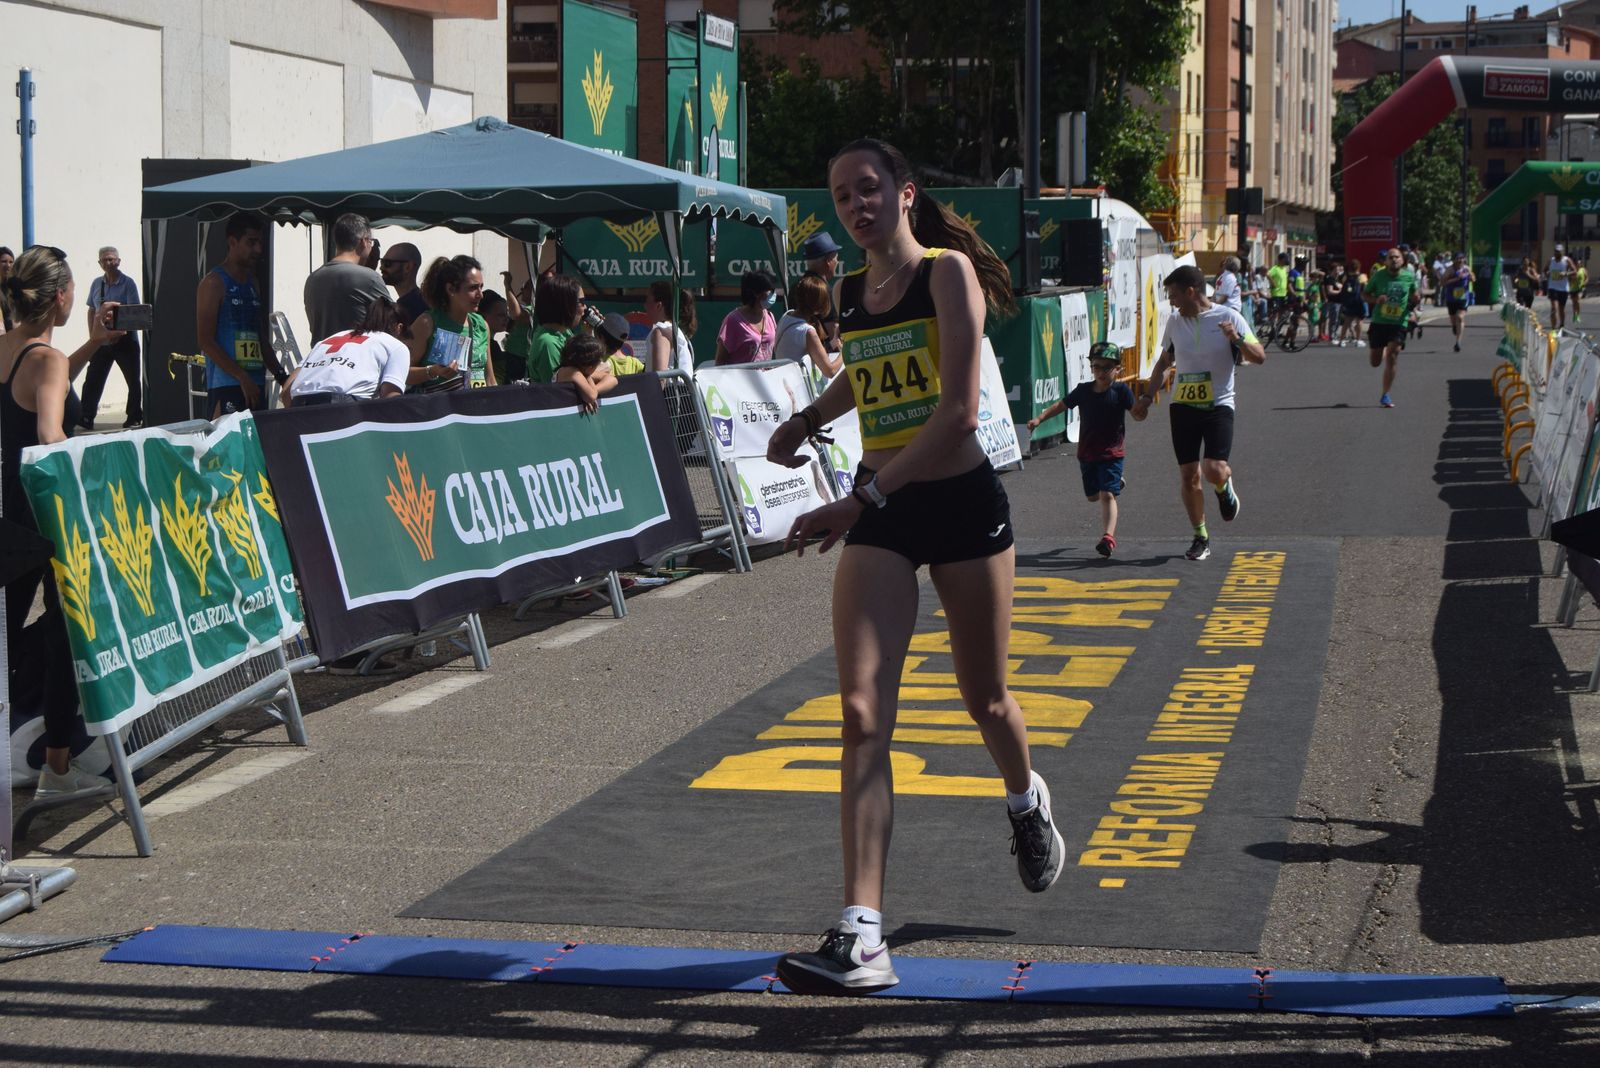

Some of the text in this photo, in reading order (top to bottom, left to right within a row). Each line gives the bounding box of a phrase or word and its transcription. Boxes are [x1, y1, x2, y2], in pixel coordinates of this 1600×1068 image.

[1563, 69, 1597, 83] CON
[1499, 84, 1545, 95] ZAMORA
[577, 258, 696, 276] CAJA RURL
[864, 340, 914, 358] CAJA RURAL
[856, 356, 928, 405] 244
[1181, 384, 1208, 400] 188
[880, 411, 907, 426] CAJA
[444, 452, 624, 544] CAJA RURAL
[1078, 551, 1287, 868] REFORMA INTEGRAL DISEÑO INTERIORES
